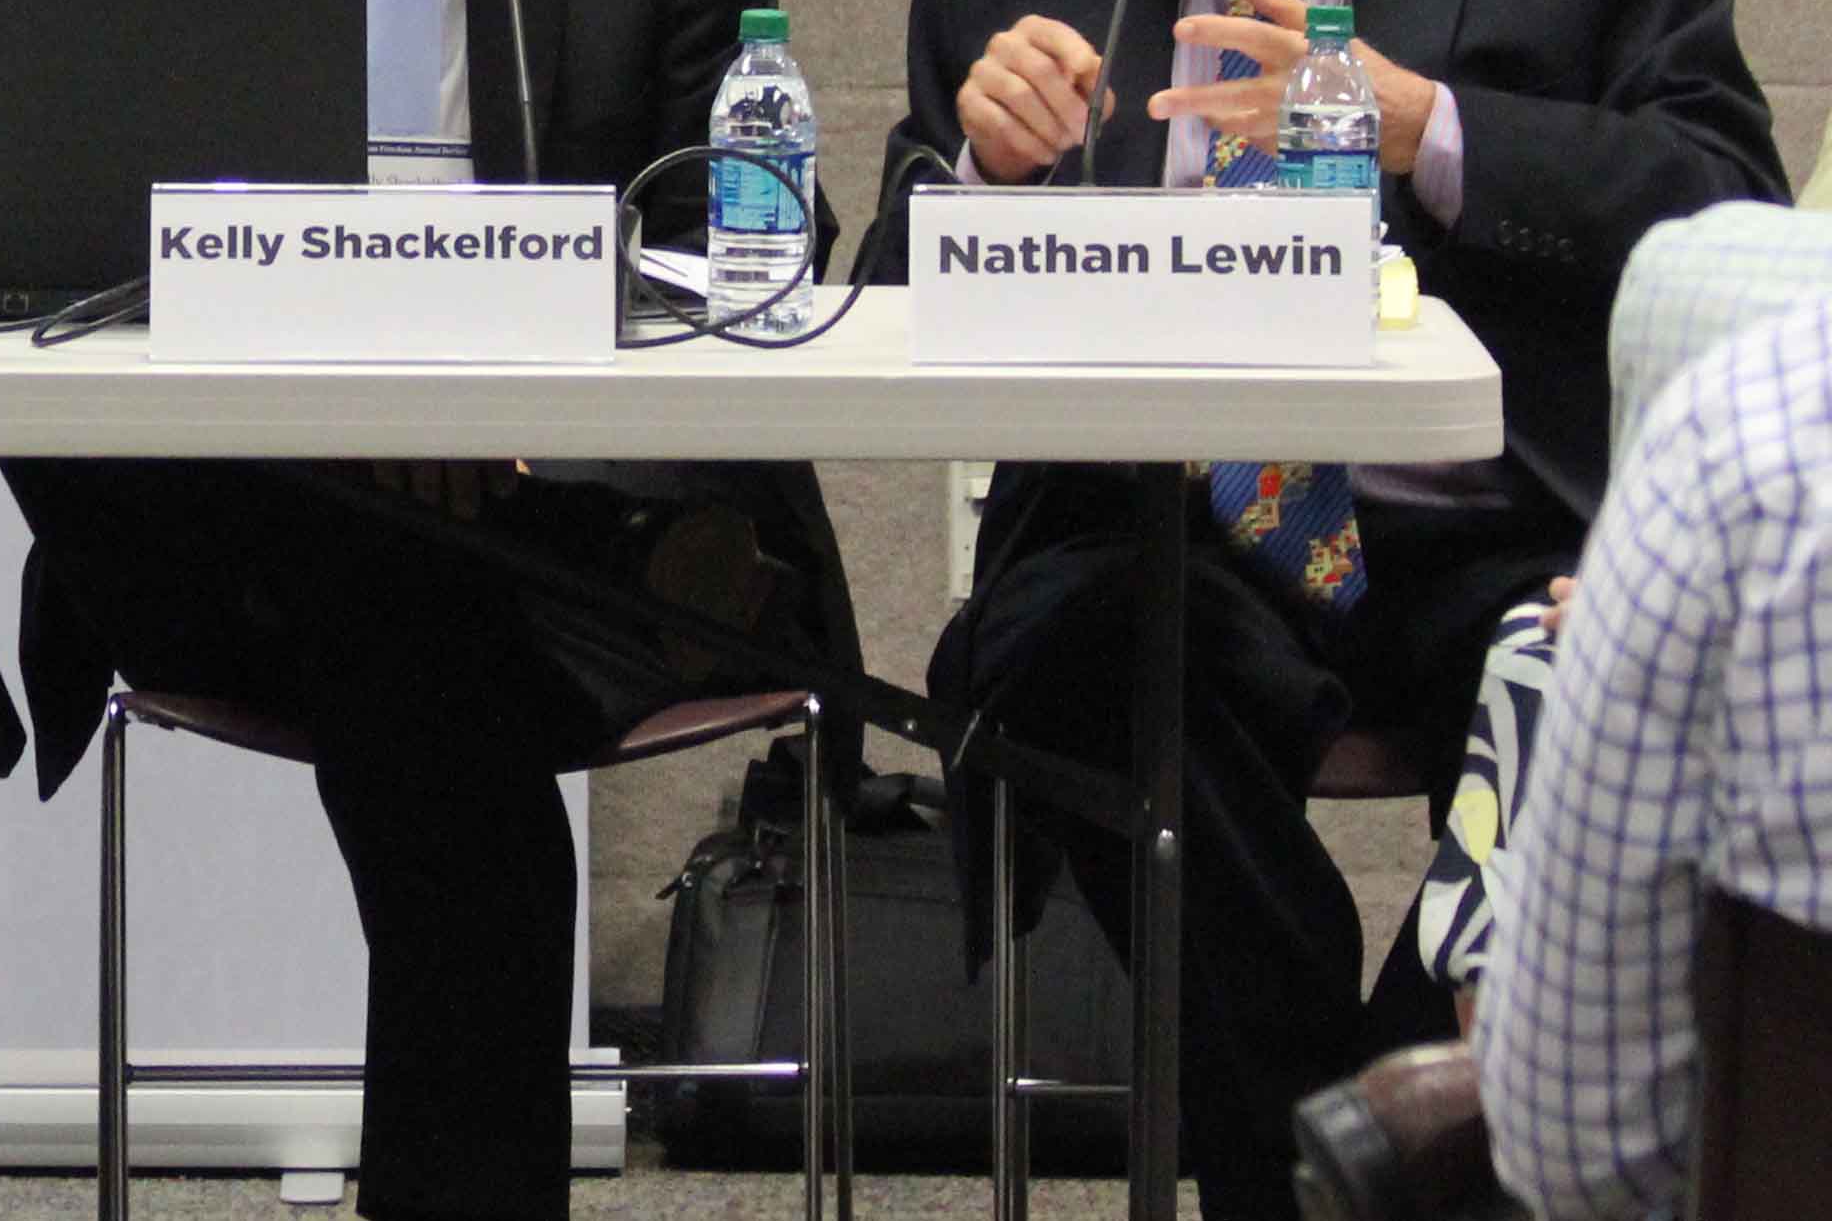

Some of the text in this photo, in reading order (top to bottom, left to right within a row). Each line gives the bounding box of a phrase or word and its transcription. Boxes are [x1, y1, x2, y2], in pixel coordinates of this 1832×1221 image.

[161, 225, 603, 266] Kelly Shackelford
[939, 234, 1342, 275] Nathan Lewin
